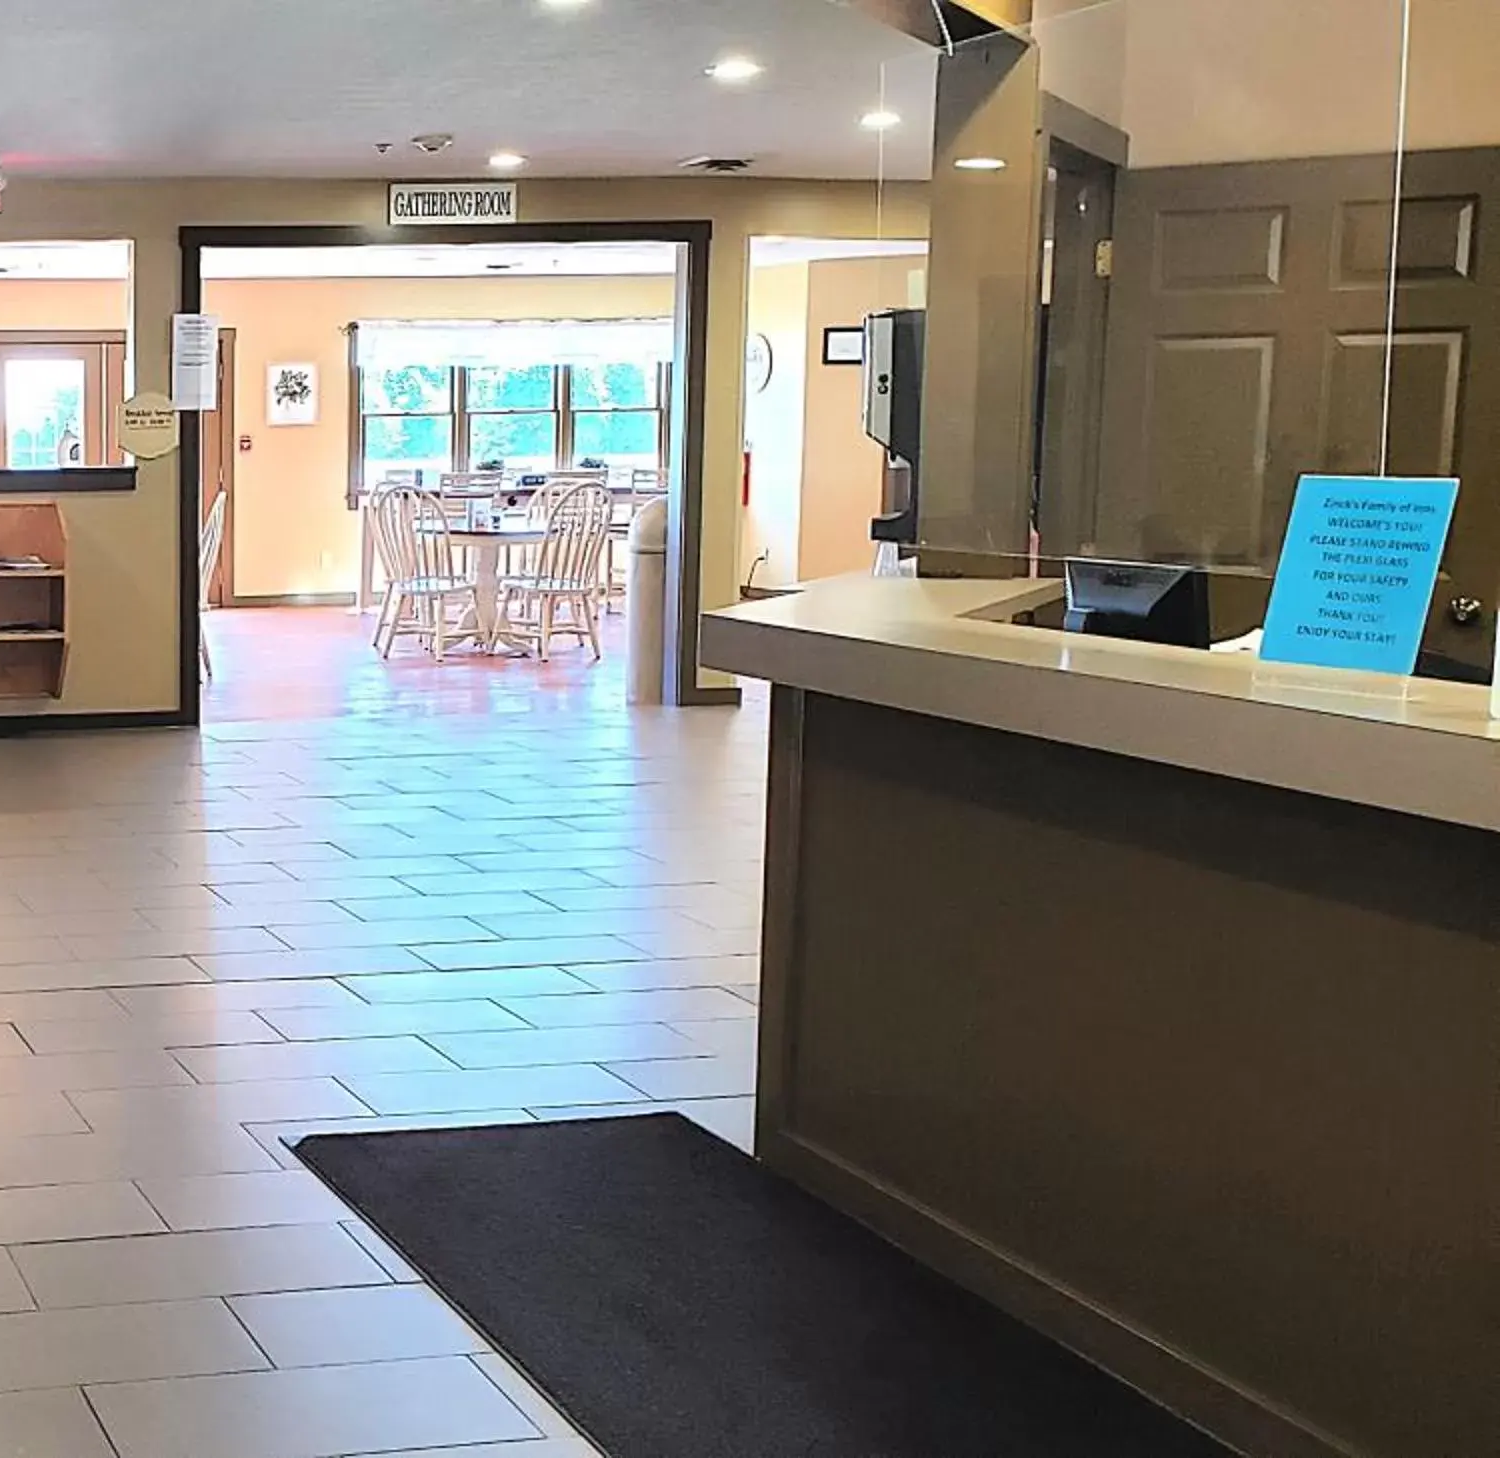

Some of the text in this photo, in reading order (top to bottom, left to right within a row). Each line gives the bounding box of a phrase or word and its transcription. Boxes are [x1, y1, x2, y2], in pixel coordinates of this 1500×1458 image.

[394, 190, 512, 217] GATHERING ROOM
[1360, 499, 1397, 513] Family
[1399, 503, 1412, 513] of
[1309, 534, 1431, 553] PLEASE STAND BEHIND
[1322, 551, 1409, 568] THE PLEXI GLASS
[1312, 569, 1336, 582] FOR
[1337, 572, 1368, 584] YOUR
[1325, 590, 1350, 602] AND
[1318, 607, 1353, 621] THANK
[1296, 624, 1330, 637] ENJOY
[1331, 628, 1361, 640] YOUR
